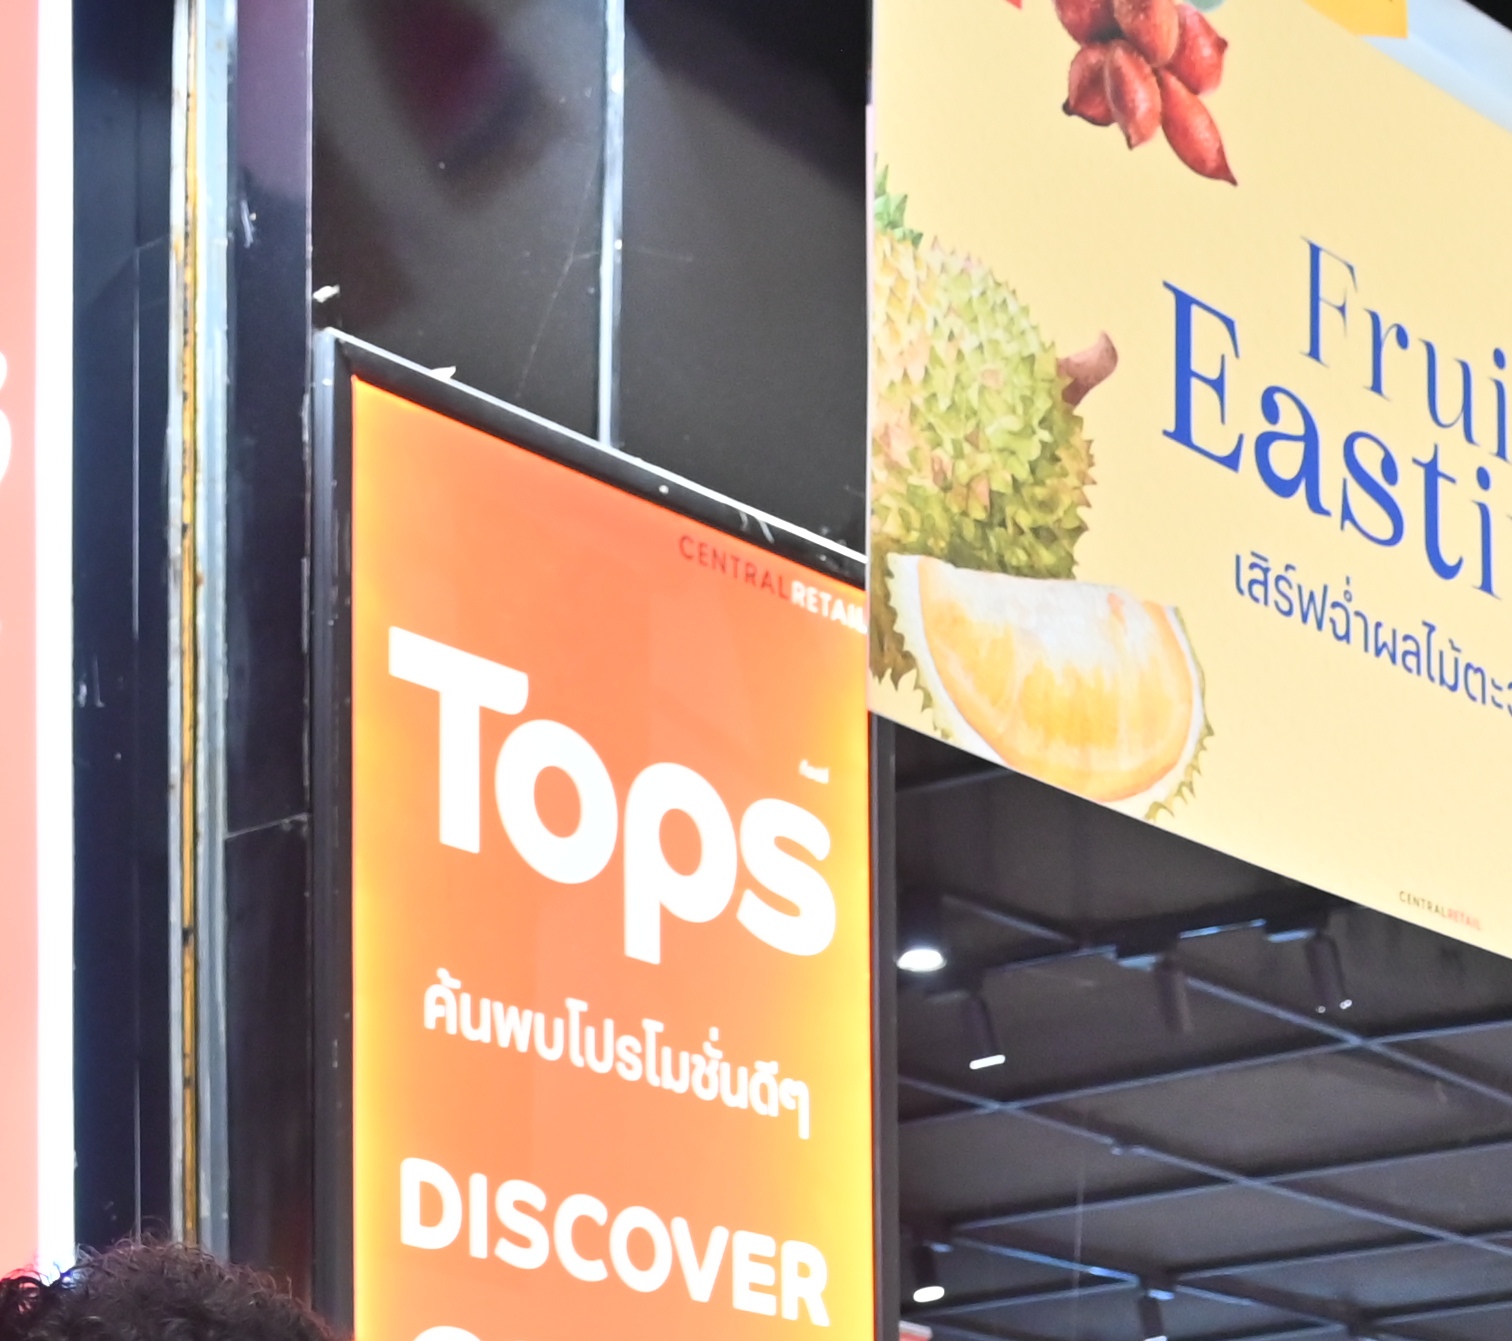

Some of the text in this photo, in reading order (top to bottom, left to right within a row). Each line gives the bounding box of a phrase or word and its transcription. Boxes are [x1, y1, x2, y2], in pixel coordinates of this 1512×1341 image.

[388, 626, 836, 965] Tops
[423, 966, 811, 1140] ค้นพบโปรโมชั่นดีๆ
[400, 1157, 831, 1327] DISCOVER
